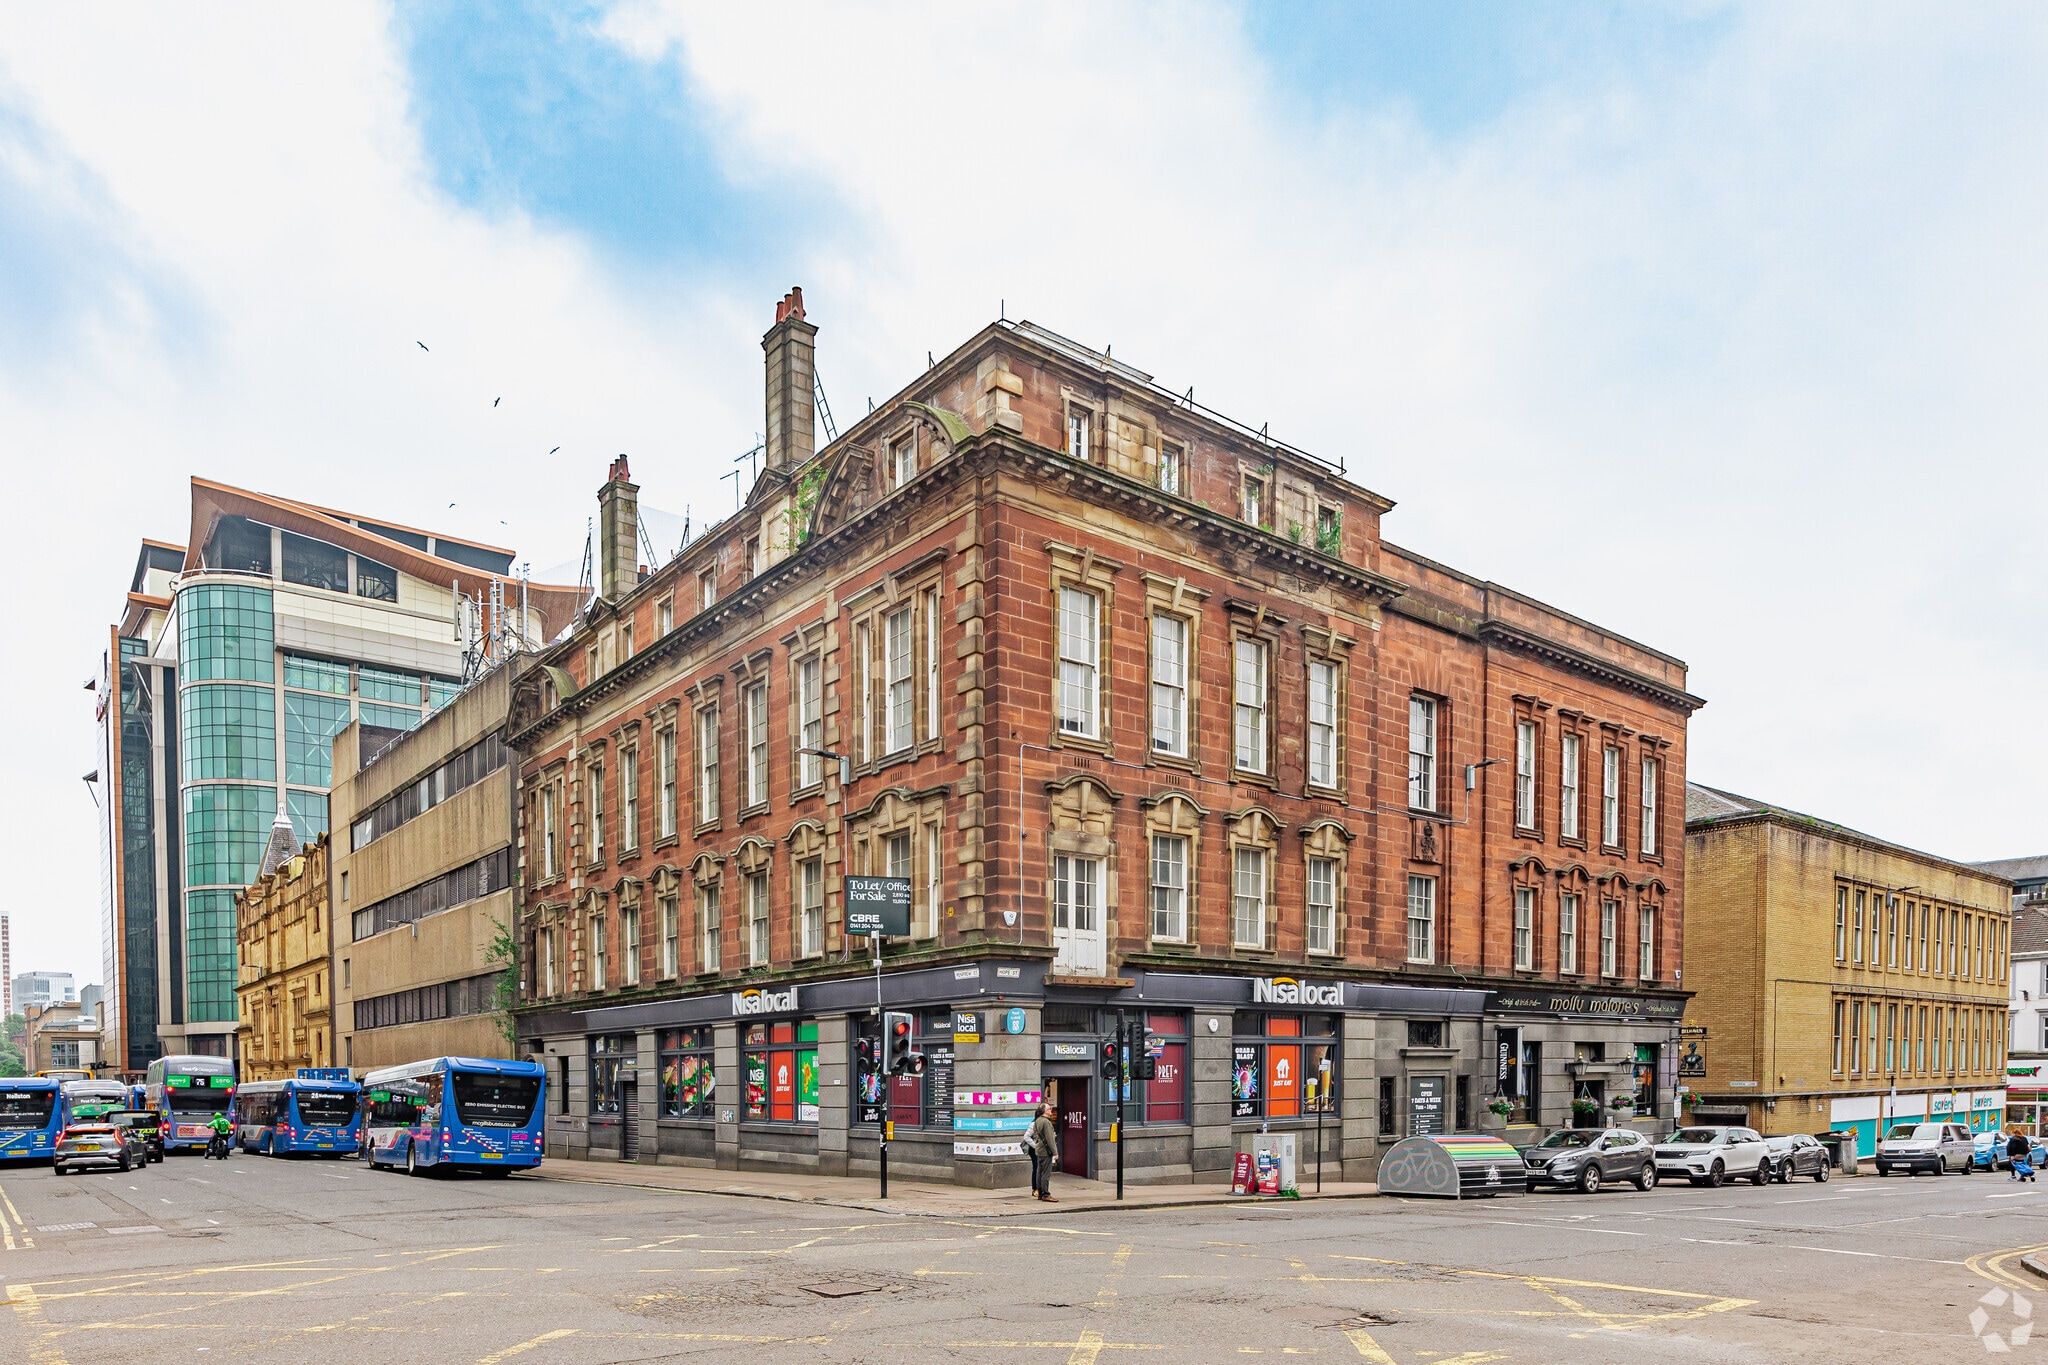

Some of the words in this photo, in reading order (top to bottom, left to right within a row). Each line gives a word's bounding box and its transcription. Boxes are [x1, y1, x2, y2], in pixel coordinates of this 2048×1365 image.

[850, 880, 864, 890] To
[850, 890, 866, 900] For
[868, 890, 886, 902] Sale
[850, 914, 880, 923] CBRE
[958, 1014, 976, 1023] Nisa
[958, 1024, 976, 1032] local
[1499, 1043, 1509, 1080] GUINNESS
[1158, 1065, 1173, 1078] PRET
[1069, 1112, 1082, 1124] PRET
